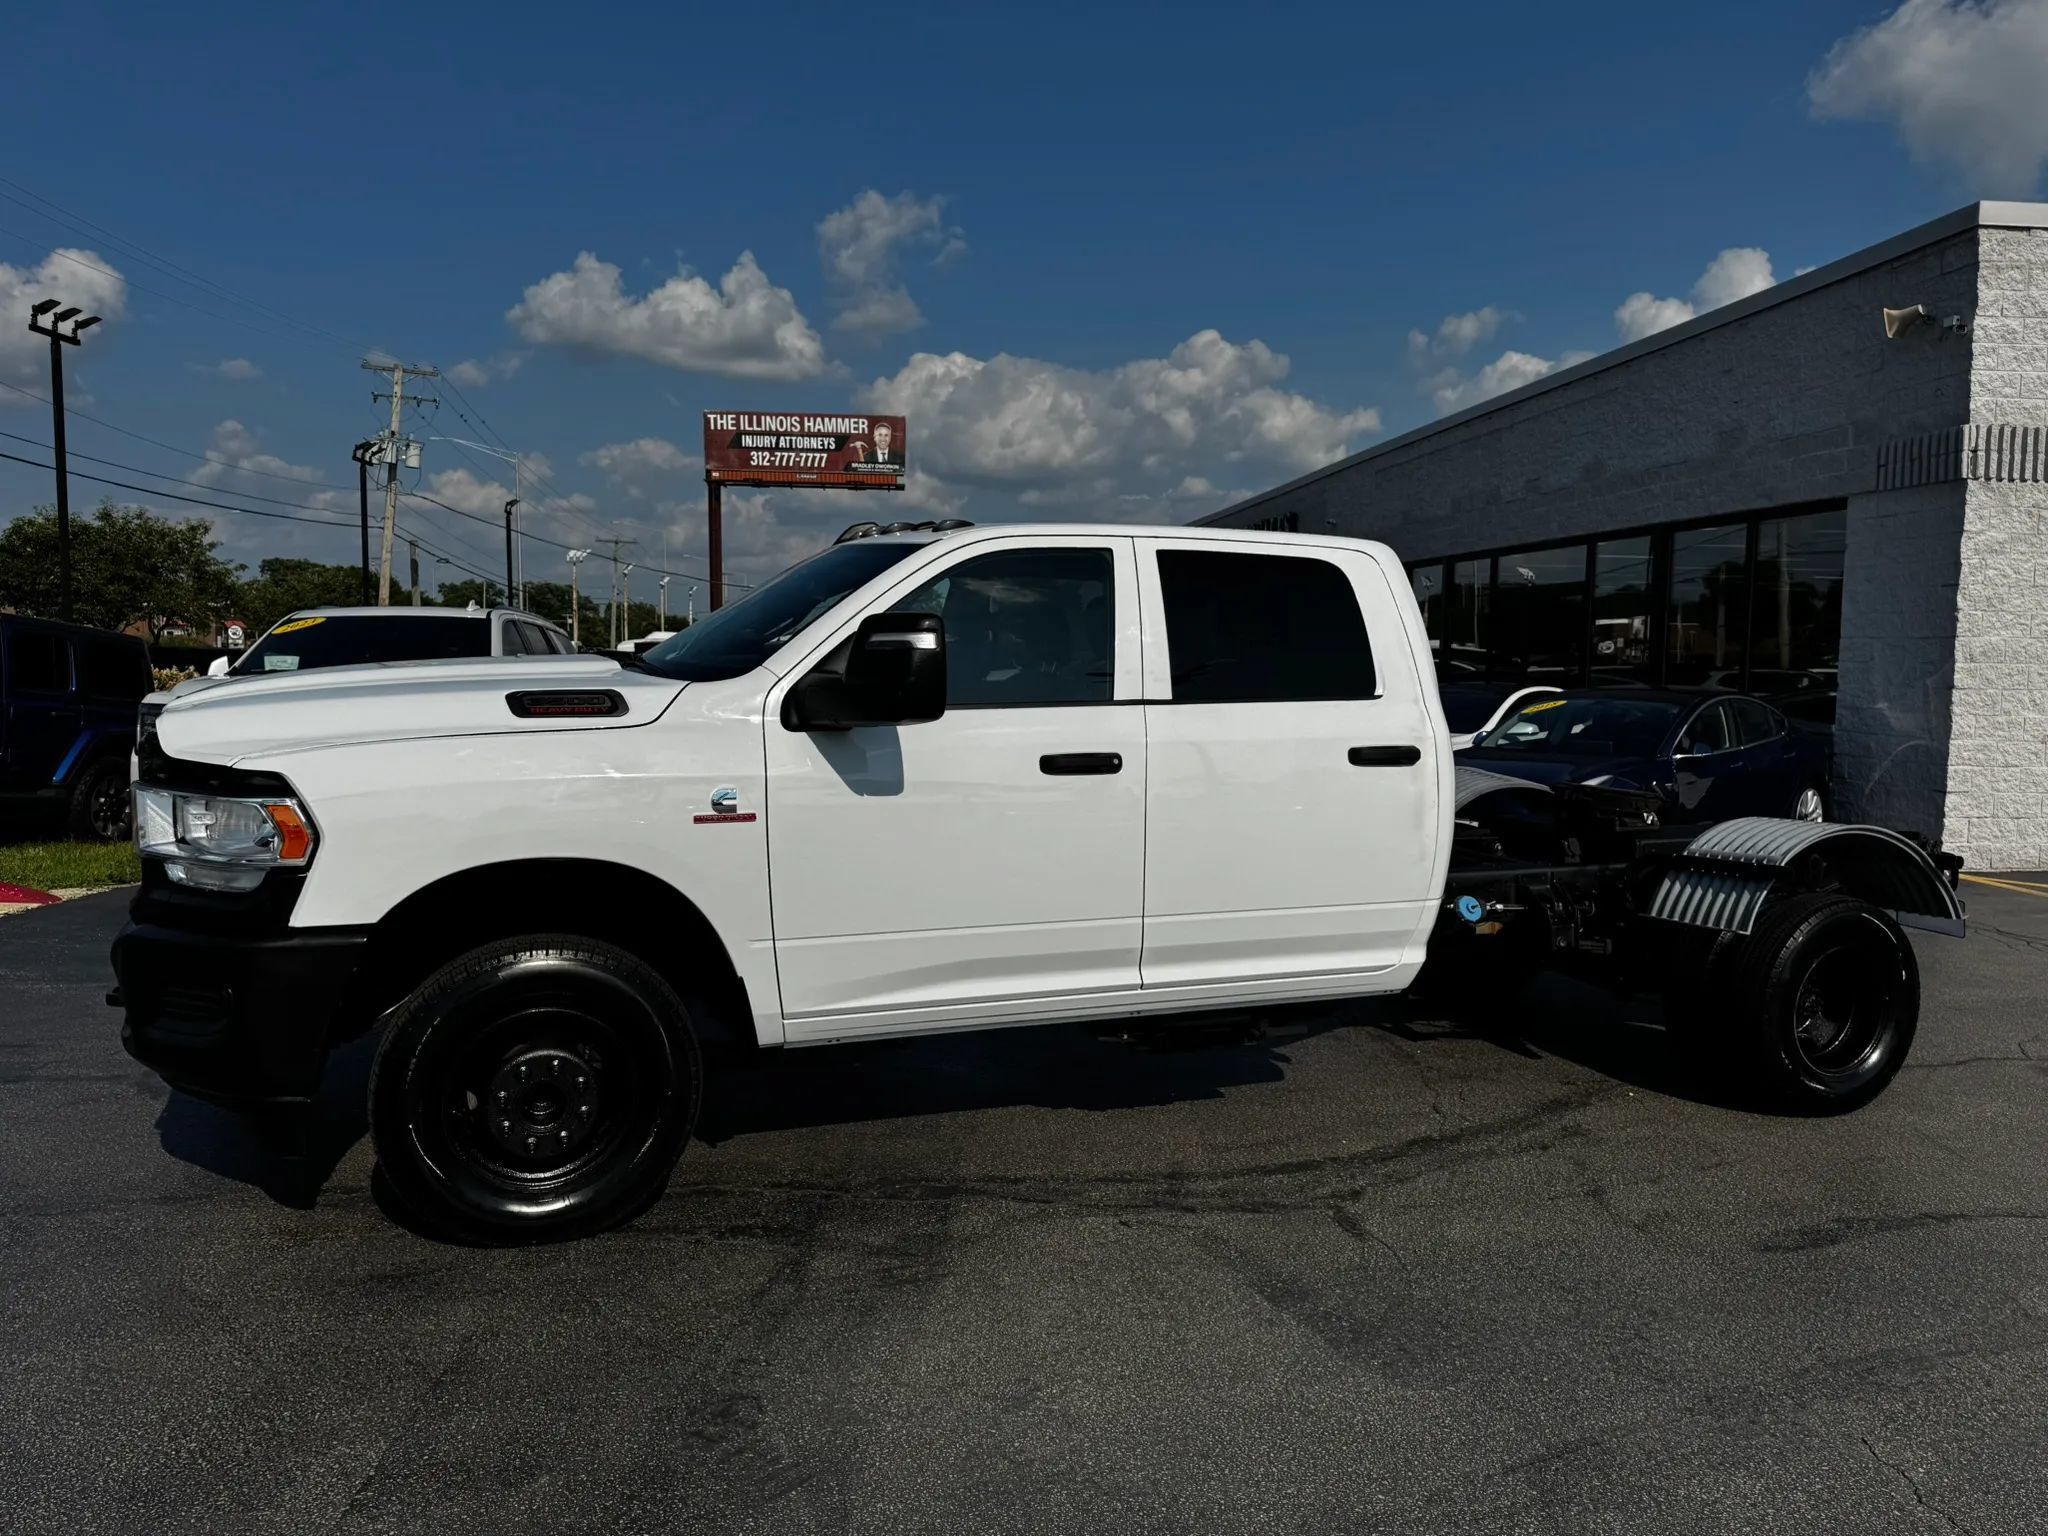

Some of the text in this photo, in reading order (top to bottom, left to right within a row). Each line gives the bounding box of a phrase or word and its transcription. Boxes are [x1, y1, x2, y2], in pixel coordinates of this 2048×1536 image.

[707, 414, 869, 434] THE ILLINOIS HAMMER
[741, 435, 836, 450] INJURY ATTORNEYS
[750, 451, 828, 467] 312-777-7777
